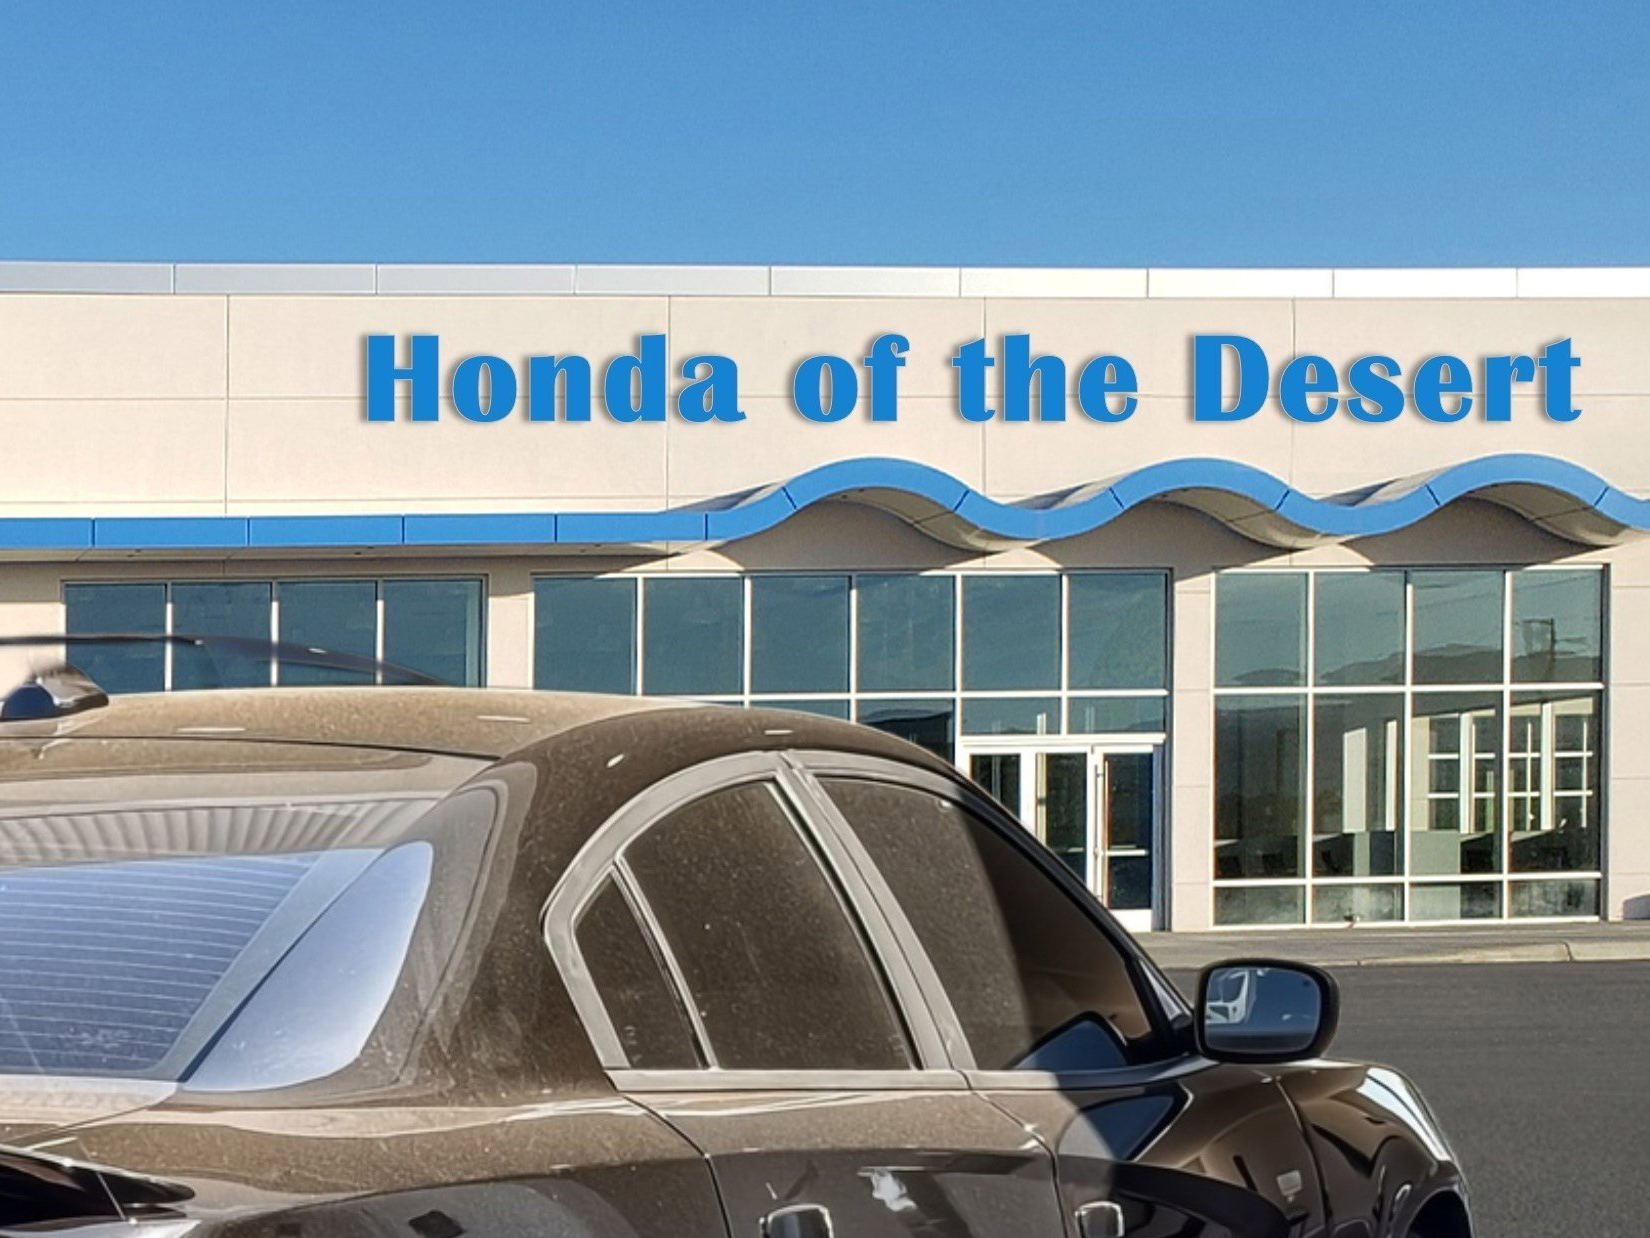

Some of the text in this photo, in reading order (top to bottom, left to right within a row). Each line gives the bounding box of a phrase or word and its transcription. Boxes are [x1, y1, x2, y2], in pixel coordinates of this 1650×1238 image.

[364, 333, 1583, 424] Honda of the Desert
